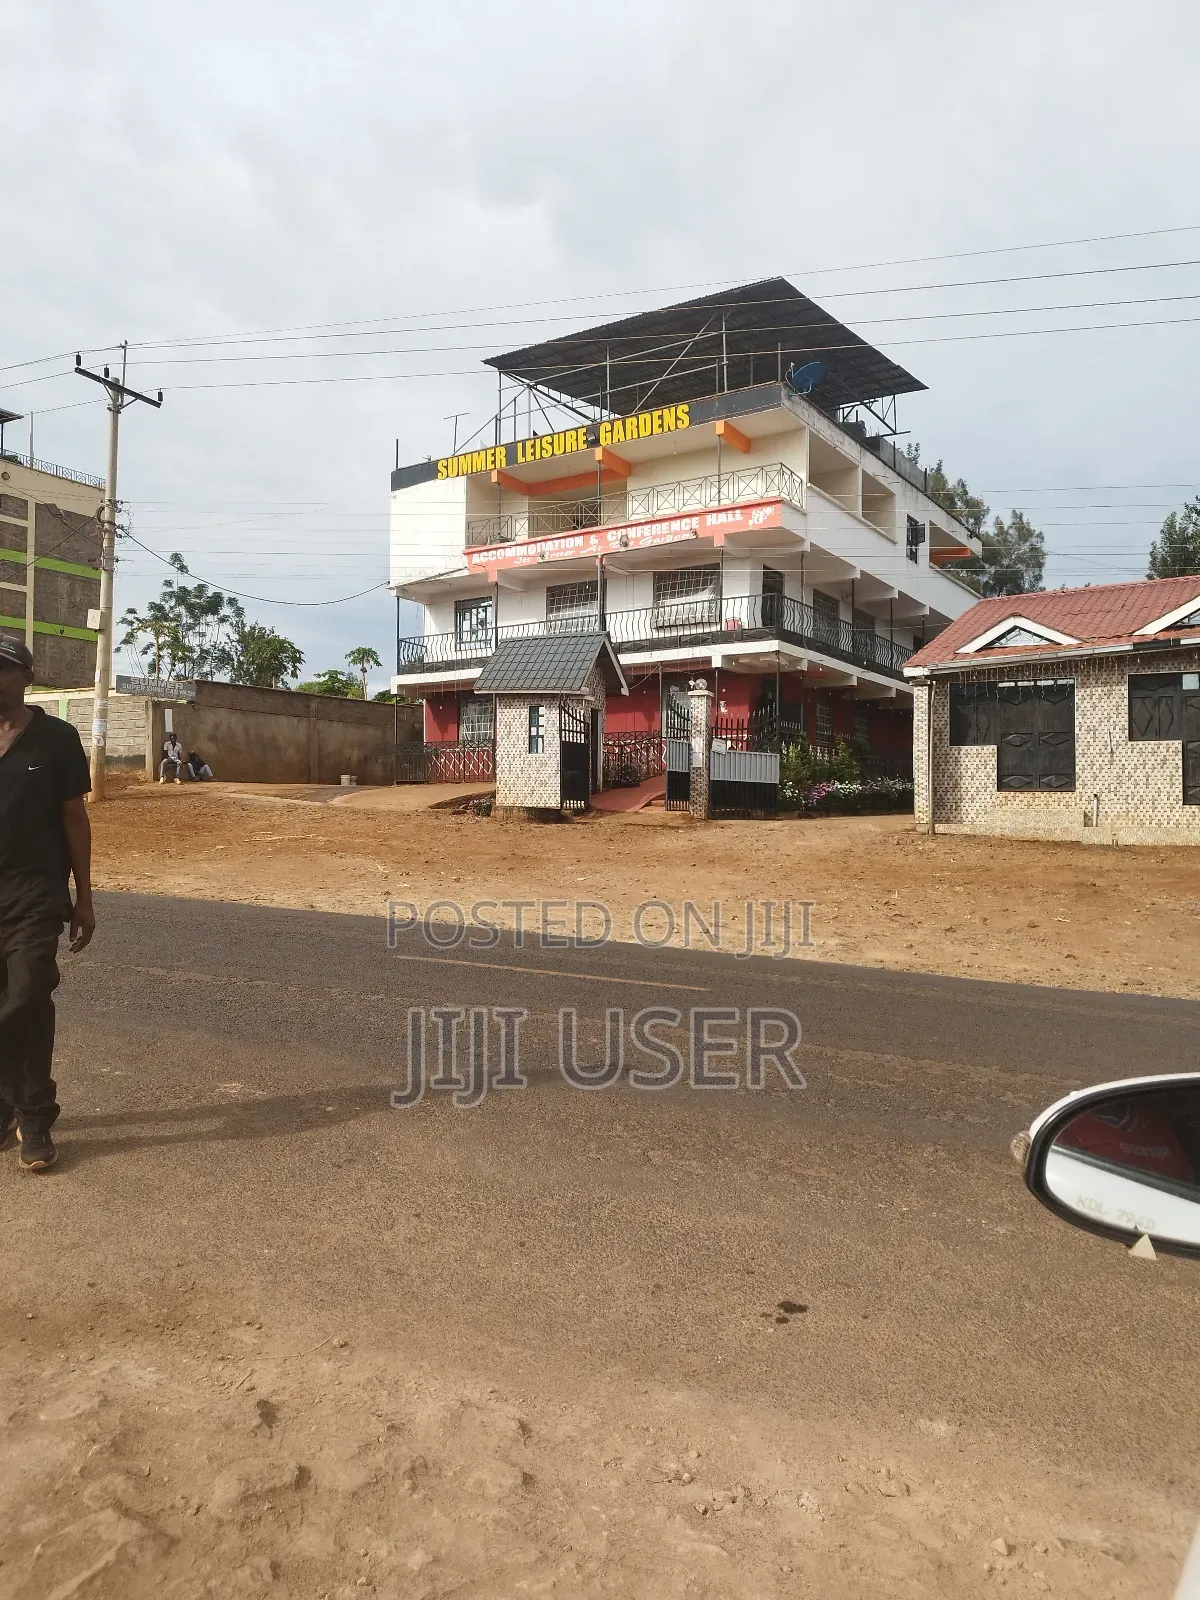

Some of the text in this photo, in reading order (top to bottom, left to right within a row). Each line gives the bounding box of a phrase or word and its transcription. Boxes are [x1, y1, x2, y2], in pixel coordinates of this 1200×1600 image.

[438, 404, 690, 480] SUMMER LEISURE GARDENS
[472, 509, 743, 564] ACCOMMODATION & CONFERENCE HALL
[131, 677, 183, 690] SUMMER
